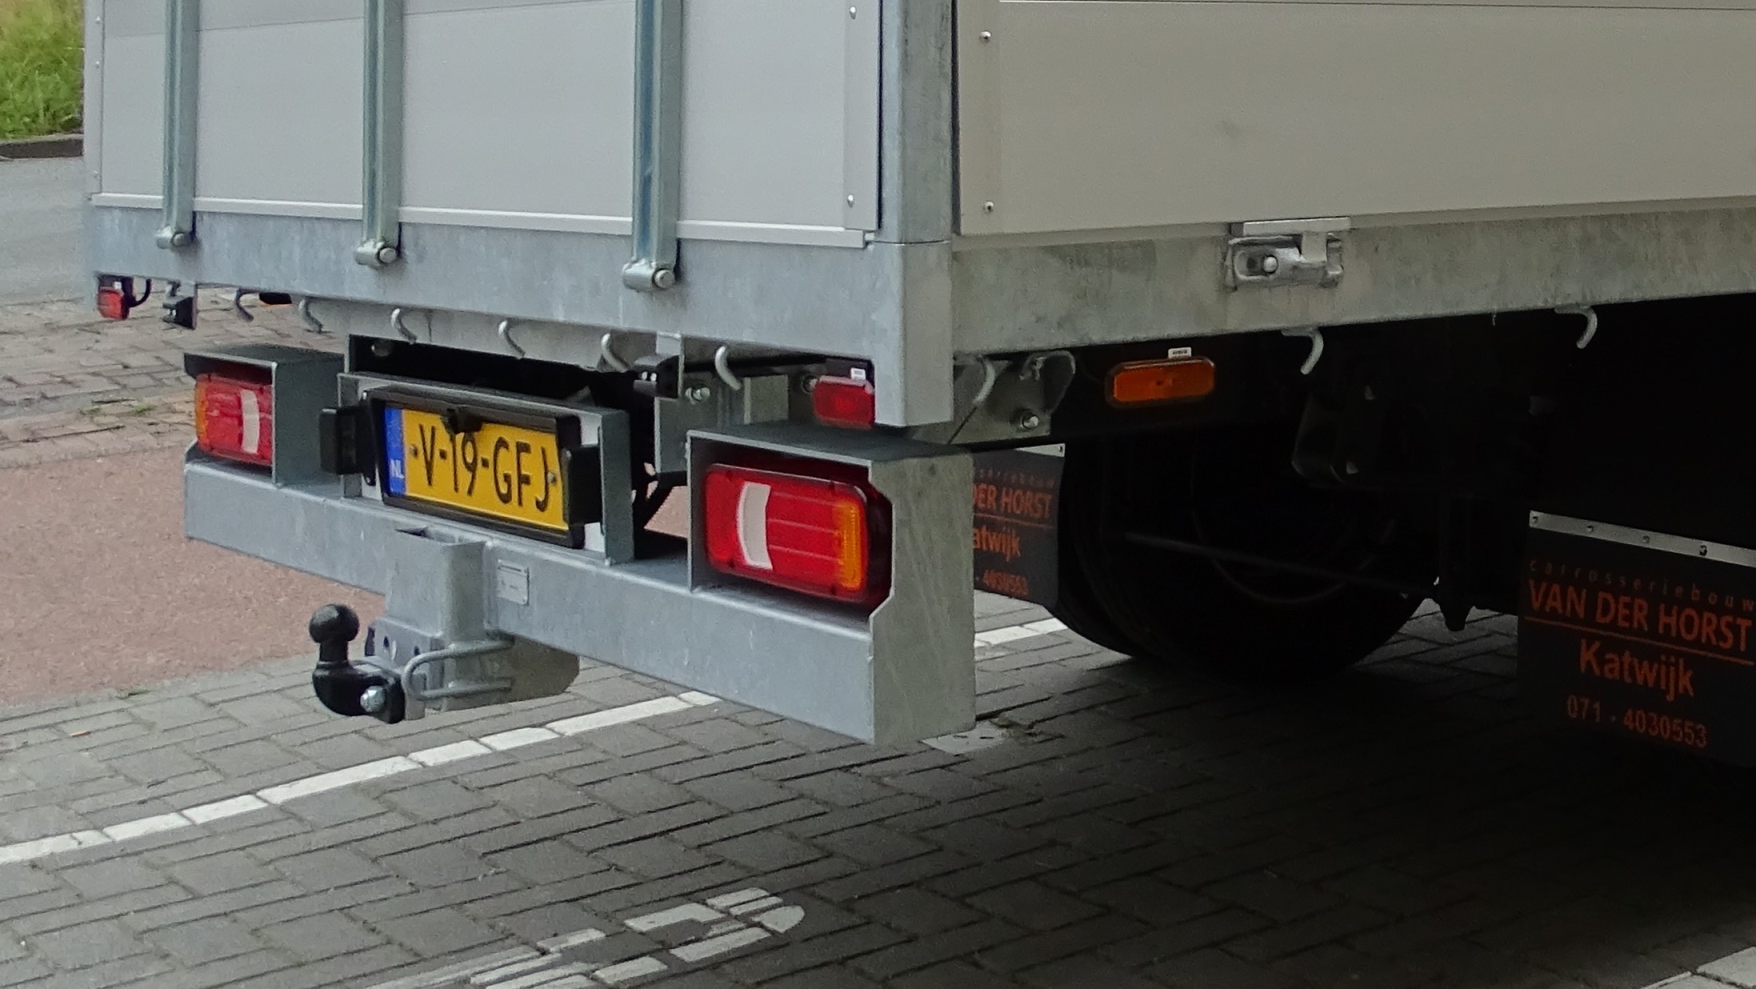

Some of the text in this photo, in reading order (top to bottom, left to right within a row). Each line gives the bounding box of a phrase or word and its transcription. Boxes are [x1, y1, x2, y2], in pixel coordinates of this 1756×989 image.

[389, 459, 405, 479] NL
[418, 423, 552, 513] V-19-GFJ
[1001, 488, 1053, 518] HORST
[1527, 579, 1753, 652] VAN DER HORST
[1579, 638, 1695, 703] Katwijk
[1566, 694, 1601, 723] 071
[1622, 707, 1710, 749] 4030553
